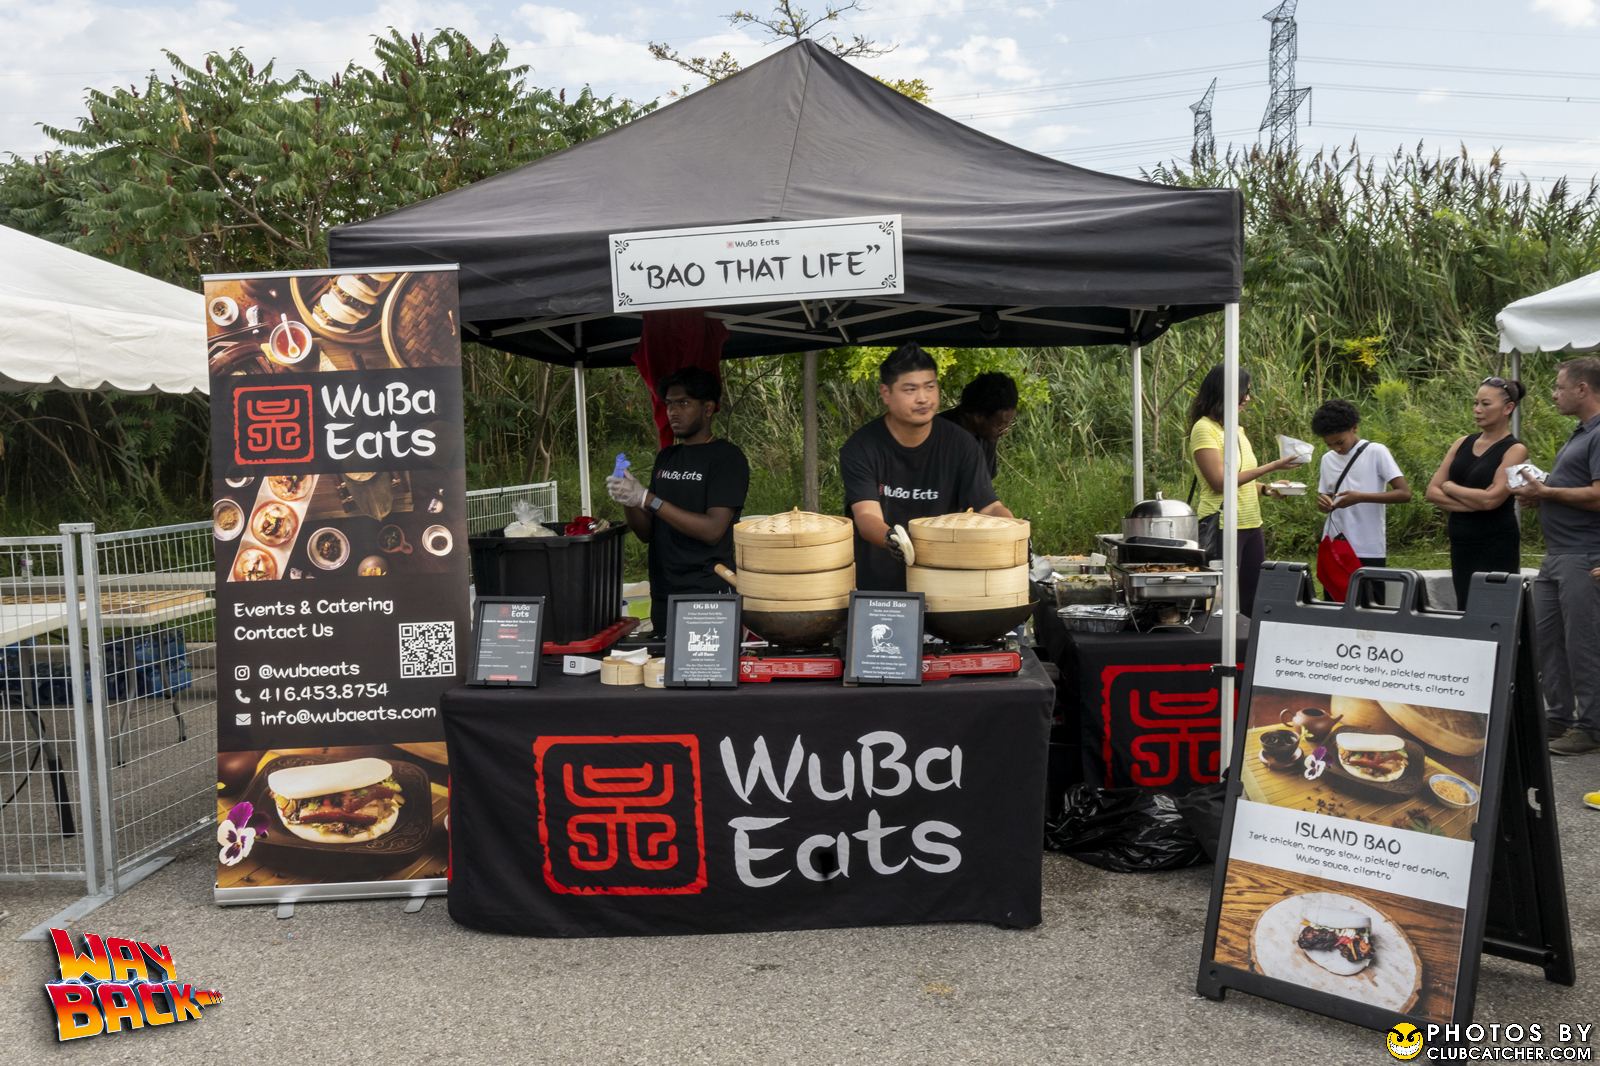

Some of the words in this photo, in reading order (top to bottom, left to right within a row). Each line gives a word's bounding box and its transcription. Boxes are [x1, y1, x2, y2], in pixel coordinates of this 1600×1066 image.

[760, 238, 780, 246] Eats
[714, 256, 792, 284] THAT
[321, 381, 436, 418] WuBa
[324, 420, 436, 460] Eats
[681, 471, 703, 481] Eats
[912, 488, 939, 500] Eats
[233, 601, 295, 617] Events
[300, 600, 312, 615] &
[317, 597, 394, 615] Catering
[892, 600, 907, 608] Bao
[233, 623, 308, 641] Contact
[312, 622, 334, 638] Us
[688, 631, 701, 644] The
[1336, 643, 1361, 659] OG
[1367, 646, 1404, 663] BAO
[259, 661, 360, 679] @wubaeats
[1306, 659, 1339, 670] braised
[1340, 663, 1361, 672] pork
[1390, 668, 1426, 679] pickled
[1427, 673, 1470, 684] mustard
[259, 683, 389, 703] 416.453.8754
[1308, 672, 1342, 682] candied
[1344, 677, 1380, 687] crushed
[1425, 684, 1465, 697] cilantro
[261, 705, 436, 726] info@wubaeats.com
[719, 730, 963, 805] WuBa
[1295, 820, 1358, 847] ISLAND
[1364, 834, 1402, 855] BAO
[727, 809, 963, 888] Eats
[1248, 830, 1268, 842] Jerk
[1307, 844, 1336, 857] mango
[1365, 855, 1400, 869] pickled
[1402, 863, 1419, 873] red
[1353, 866, 1392, 881] cilantro
